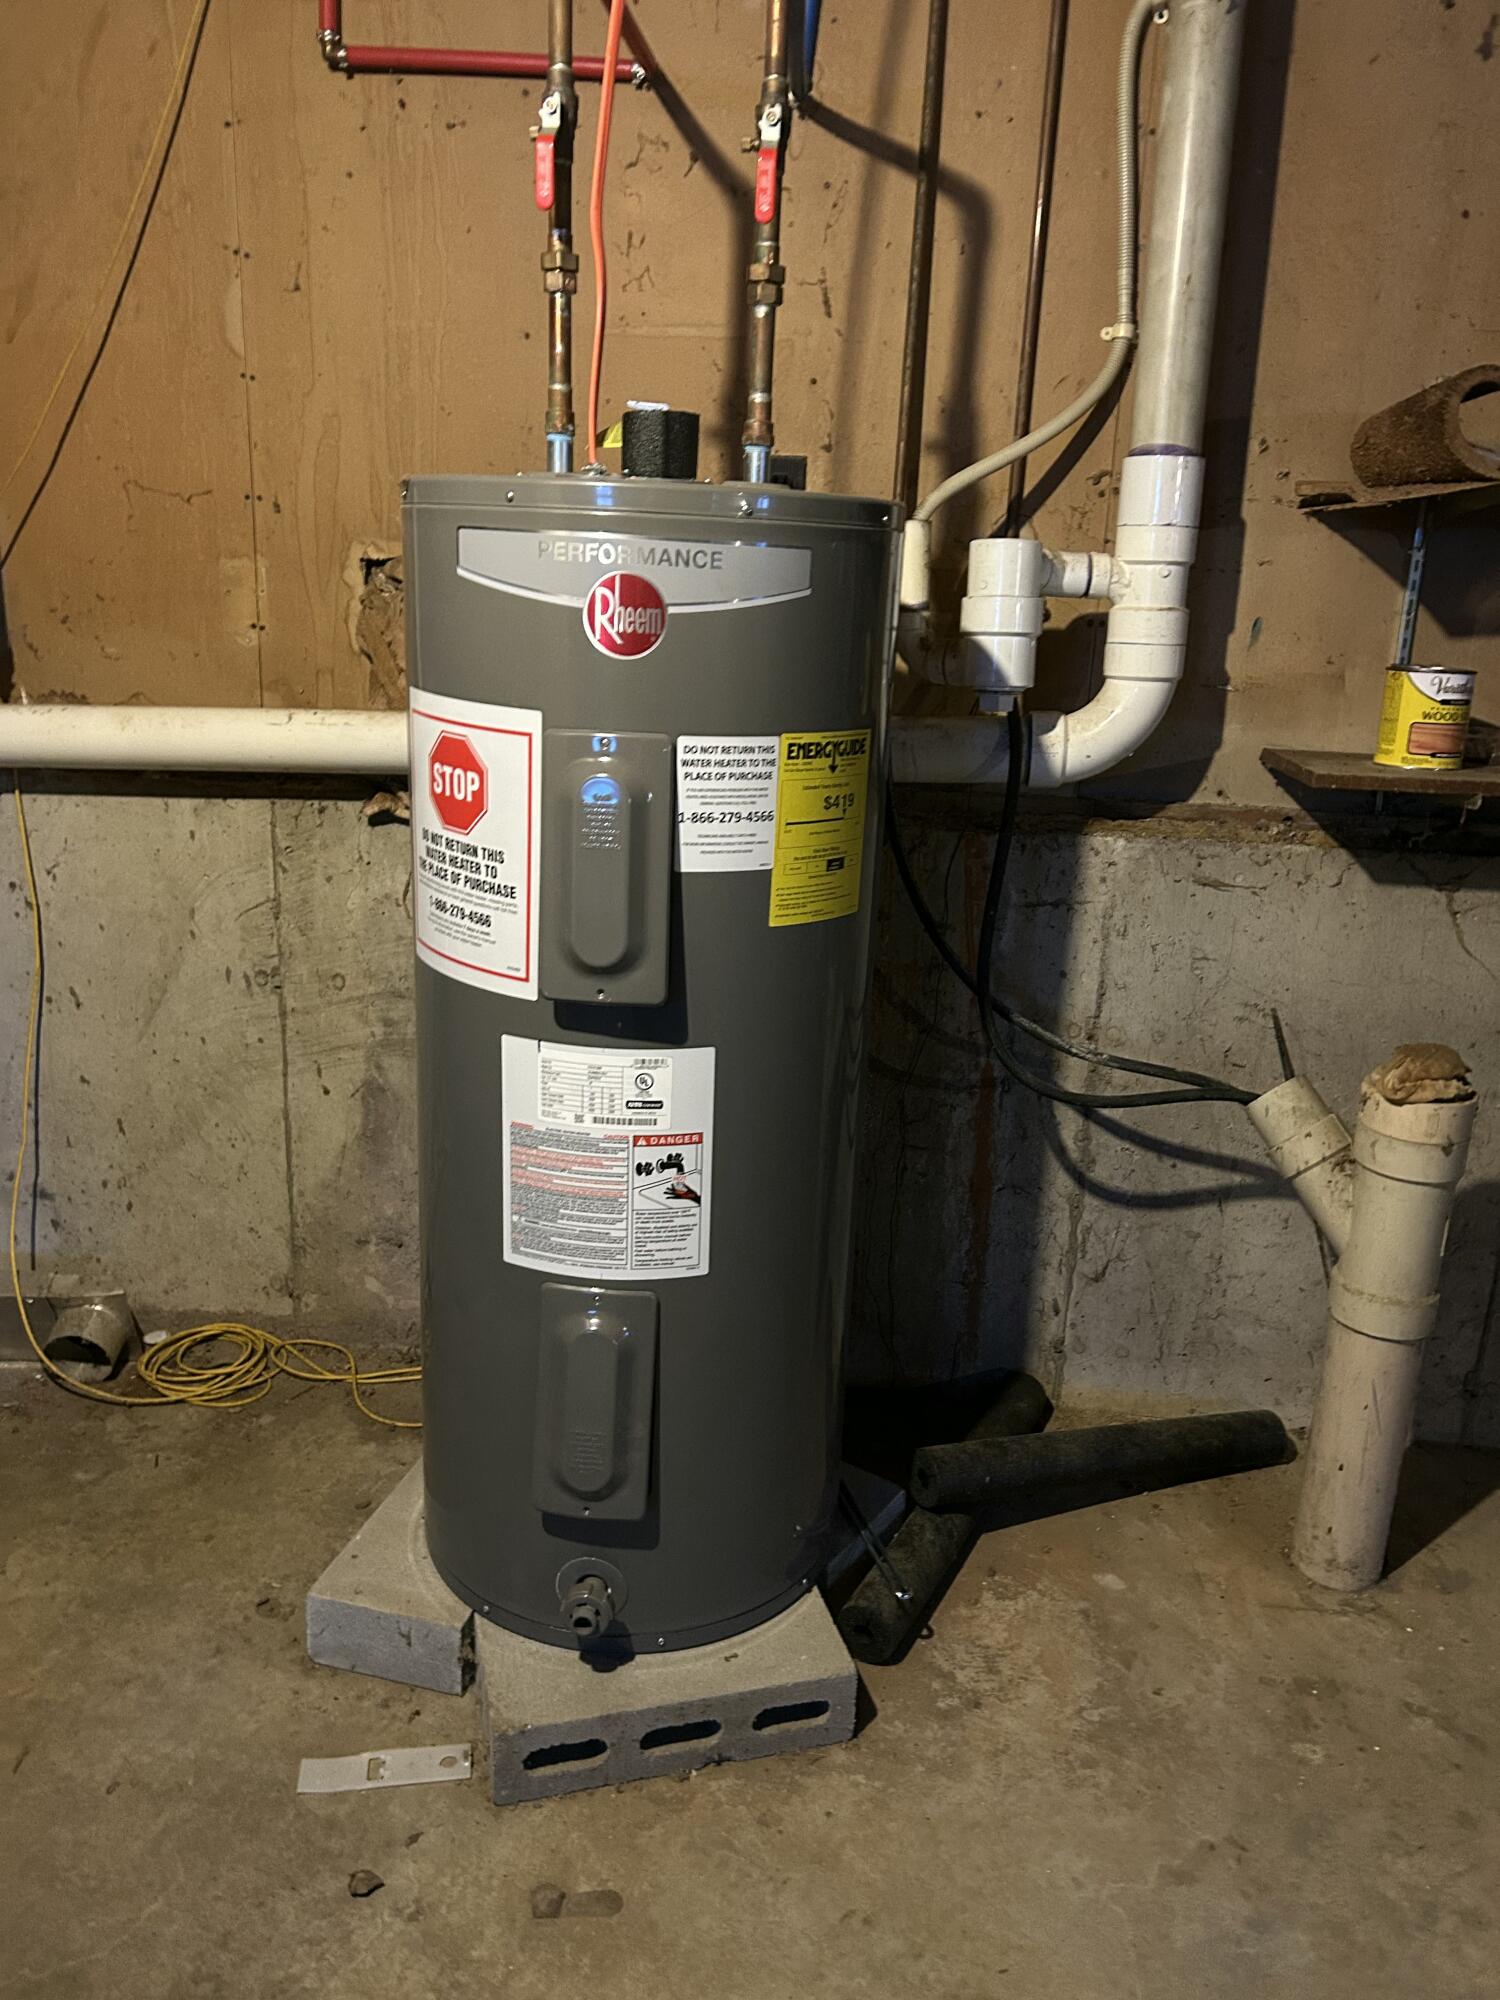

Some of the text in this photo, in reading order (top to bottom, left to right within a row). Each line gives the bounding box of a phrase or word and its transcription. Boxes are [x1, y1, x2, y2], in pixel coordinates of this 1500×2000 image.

[538, 540, 723, 570] PERFORMANCE
[594, 573, 663, 645] Rheem
[1422, 711, 1458, 722] WOOD
[683, 745, 776, 755] DO NOT RETURN THIS
[681, 759, 712, 768] WATER
[713, 758, 748, 768] HEATER
[749, 758, 760, 768] TO
[760, 758, 777, 767] THE
[433, 761, 480, 802] STOP
[684, 771, 774, 781] PLACE OF PURCHASE
[823, 792, 855, 811] $419
[678, 810, 775, 824] 1-866-279-4566
[431, 830, 443, 845] NOT
[445, 836, 478, 858] RETURN
[481, 847, 505, 865] THIS
[426, 845, 498, 879] WATER HEATER TO
[428, 862, 449, 882] PLACE
[450, 870, 463, 886] OF
[464, 874, 517, 900] PURCHASE
[650, 1134, 700, 1146] DANGER
